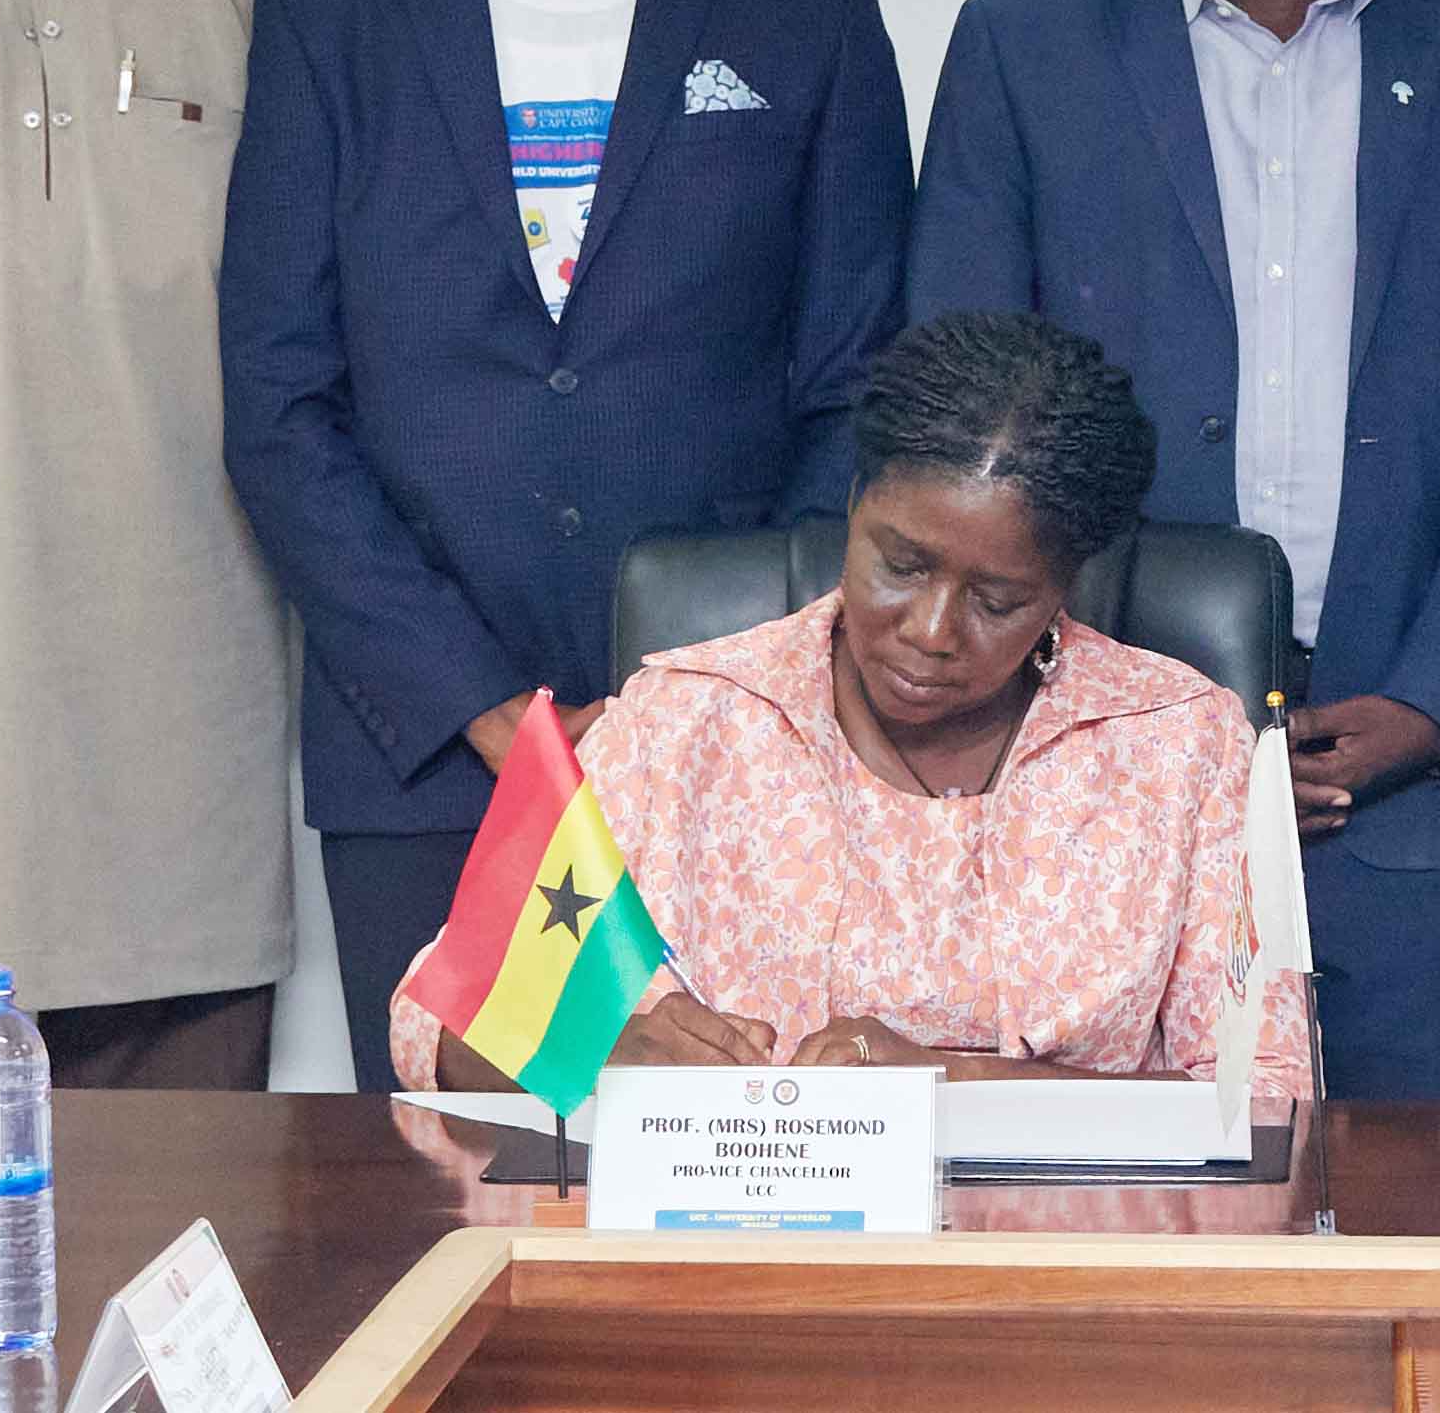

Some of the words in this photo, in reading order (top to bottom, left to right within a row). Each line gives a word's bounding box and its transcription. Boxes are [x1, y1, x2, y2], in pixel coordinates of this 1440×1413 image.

[641, 1117, 700, 1134] PROF.
[708, 1117, 767, 1137] (MRS)
[775, 1119, 886, 1135] ROSEMOND
[715, 1143, 811, 1159] BOOHENE
[673, 1164, 743, 1178] PRO-VICE
[750, 1165, 851, 1179] CHANCELLOR
[745, 1184, 777, 1197] UCC
